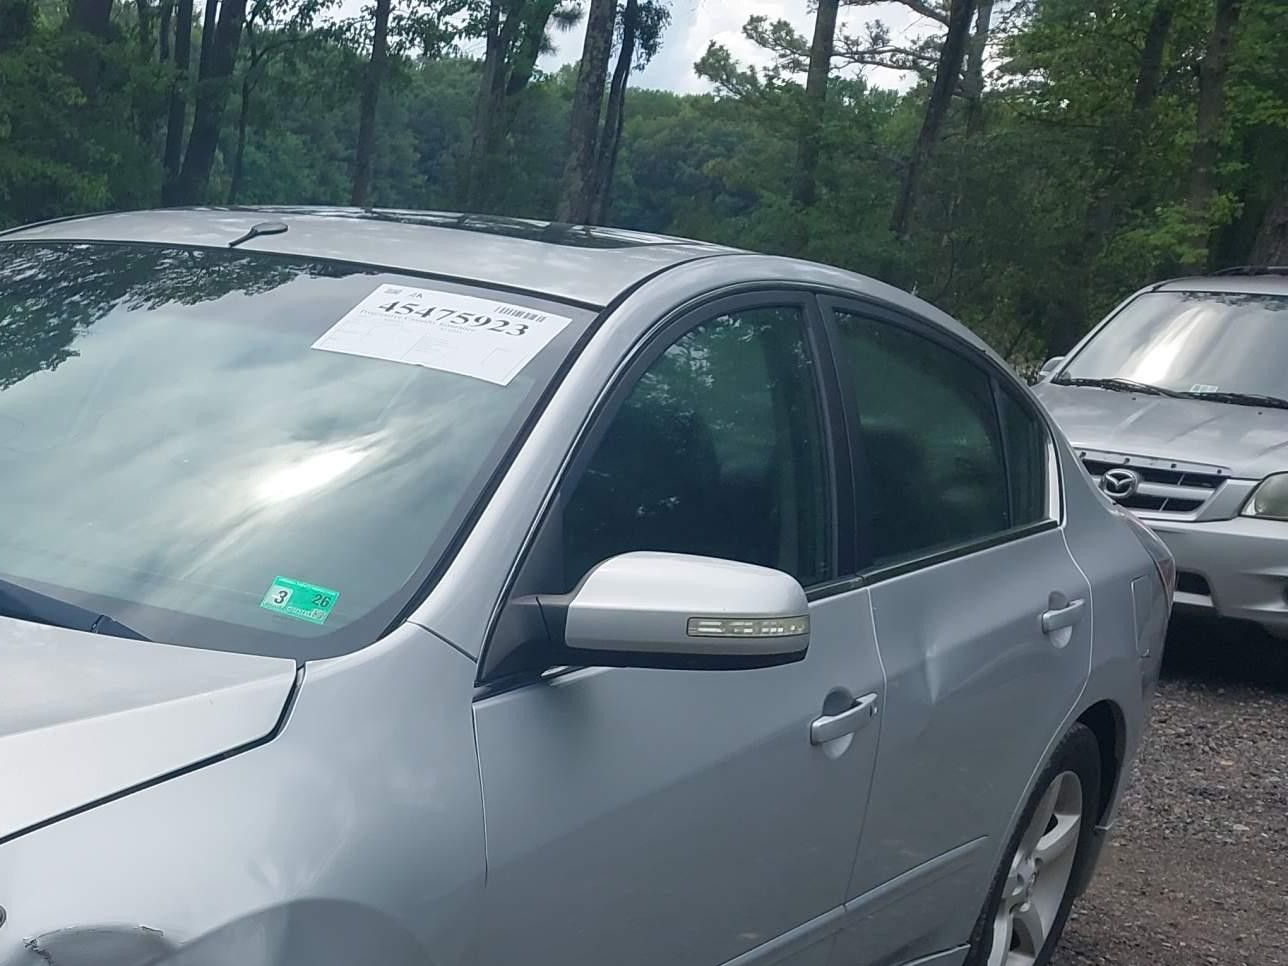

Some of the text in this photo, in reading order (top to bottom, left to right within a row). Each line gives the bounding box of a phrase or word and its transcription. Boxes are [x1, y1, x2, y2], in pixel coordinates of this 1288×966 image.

[378, 301, 529, 336] 45475923
[274, 590, 332, 608] 3 26
